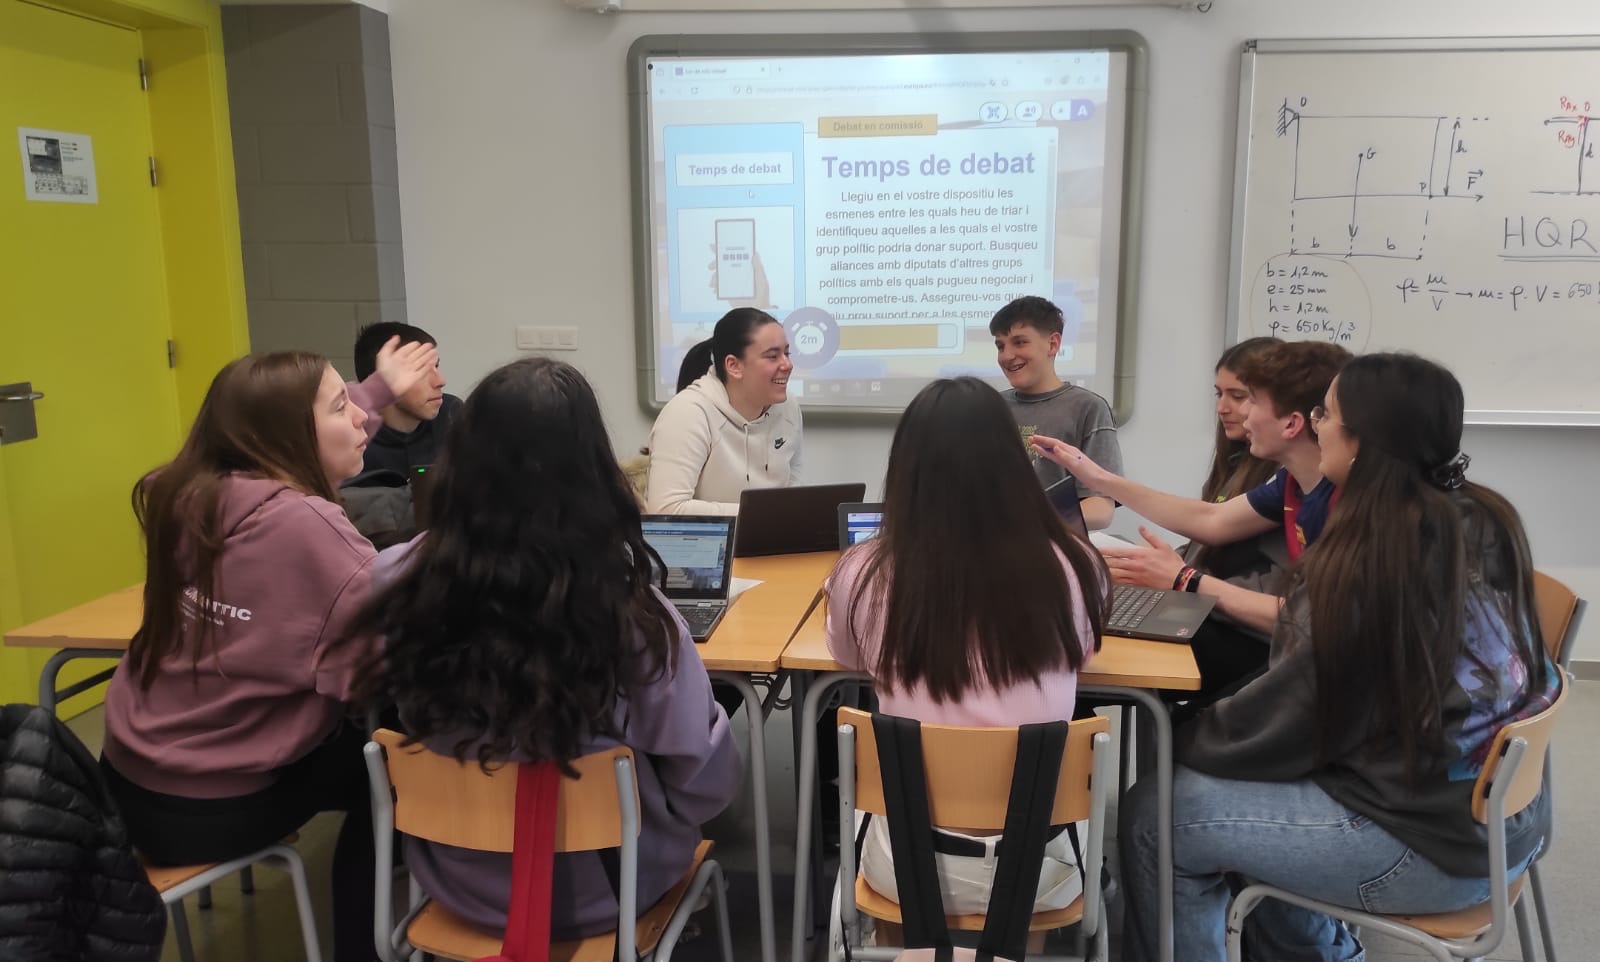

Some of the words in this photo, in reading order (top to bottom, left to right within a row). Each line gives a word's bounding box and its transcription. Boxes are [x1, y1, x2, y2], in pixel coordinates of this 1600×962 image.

[1077, 104, 1089, 117] A
[833, 122, 862, 131] Debat
[864, 123, 876, 131] en
[688, 164, 728, 177] Temps
[731, 163, 745, 174] de
[748, 163, 782, 174] debat
[822, 156, 910, 182] Temps
[919, 154, 950, 176] de
[960, 152, 1035, 175] debat
[841, 192, 873, 203] Llegiu
[877, 193, 890, 201] en
[894, 191, 903, 200] el
[907, 191, 940, 200] vostre
[943, 190, 994, 202] dispositiu
[998, 189, 1013, 198] les
[826, 210, 875, 219] esmenes
[879, 209, 905, 218] entre
[910, 208, 924, 217] les
[928, 207, 957, 220] quals
[961, 207, 980, 216] heu
[984, 206, 997, 216] de
[1002, 206, 1021, 215] triar
[816, 226, 878, 238] identifiqueu
[882, 225, 926, 237] aquelles
[940, 224, 955, 234] les
[959, 224, 988, 236] quals
[991, 224, 1001, 233] el
[1004, 223, 1037, 232] vostre
[816, 245, 839, 256] grup
[843, 243, 875, 256] polític
[878, 242, 911, 255] podria
[915, 242, 945, 251] donar
[949, 241, 986, 253] suport.
[990, 241, 1037, 252] Busqueu
[830, 260, 874, 271] aliances
[878, 259, 901, 270] amb
[904, 258, 946, 271] diputats
[950, 258, 989, 268] d'altres
[992, 259, 1023, 269] grups
[819, 277, 856, 289] polítics
[860, 276, 883, 287] amb
[887, 276, 901, 286] els
[905, 275, 933, 288] quals
[937, 276, 977, 288] pugueu
[981, 275, 1027, 286] negociar
[827, 294, 918, 306] comprometre-us.
[921, 293, 1001, 305] Assegureu-vos
[1004, 292, 1024, 302] que
[961, 310, 995, 318] esmen
[800, 334, 818, 344] 2m
